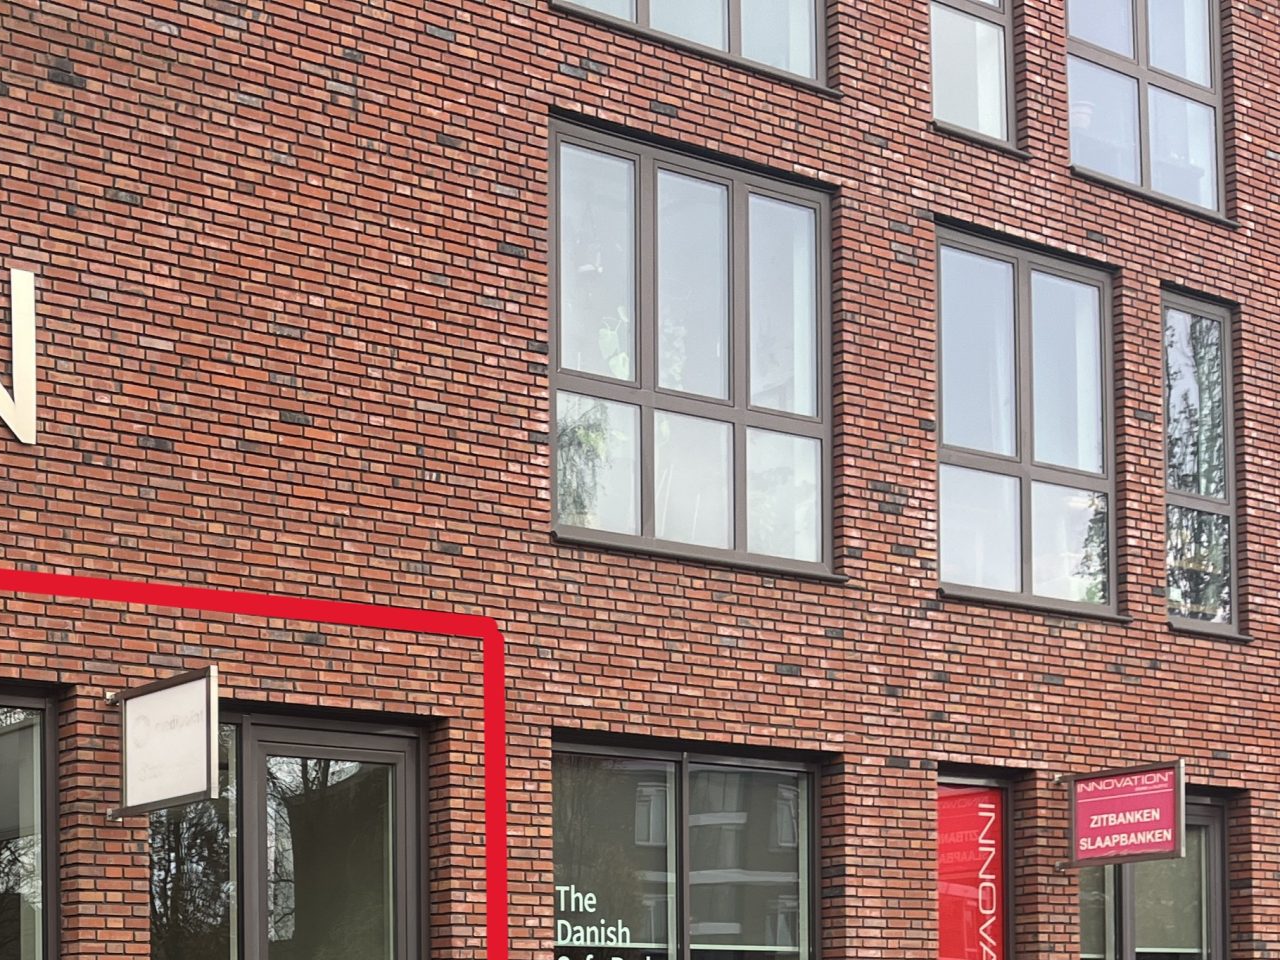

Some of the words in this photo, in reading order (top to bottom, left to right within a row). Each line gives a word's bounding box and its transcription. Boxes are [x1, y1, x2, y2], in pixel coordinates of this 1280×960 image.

[1089, 808, 1160, 828] ZITBANKEN
[1079, 829, 1172, 851] SLAAPBANKEN
[555, 884, 597, 913] The
[556, 918, 631, 946] Danish
